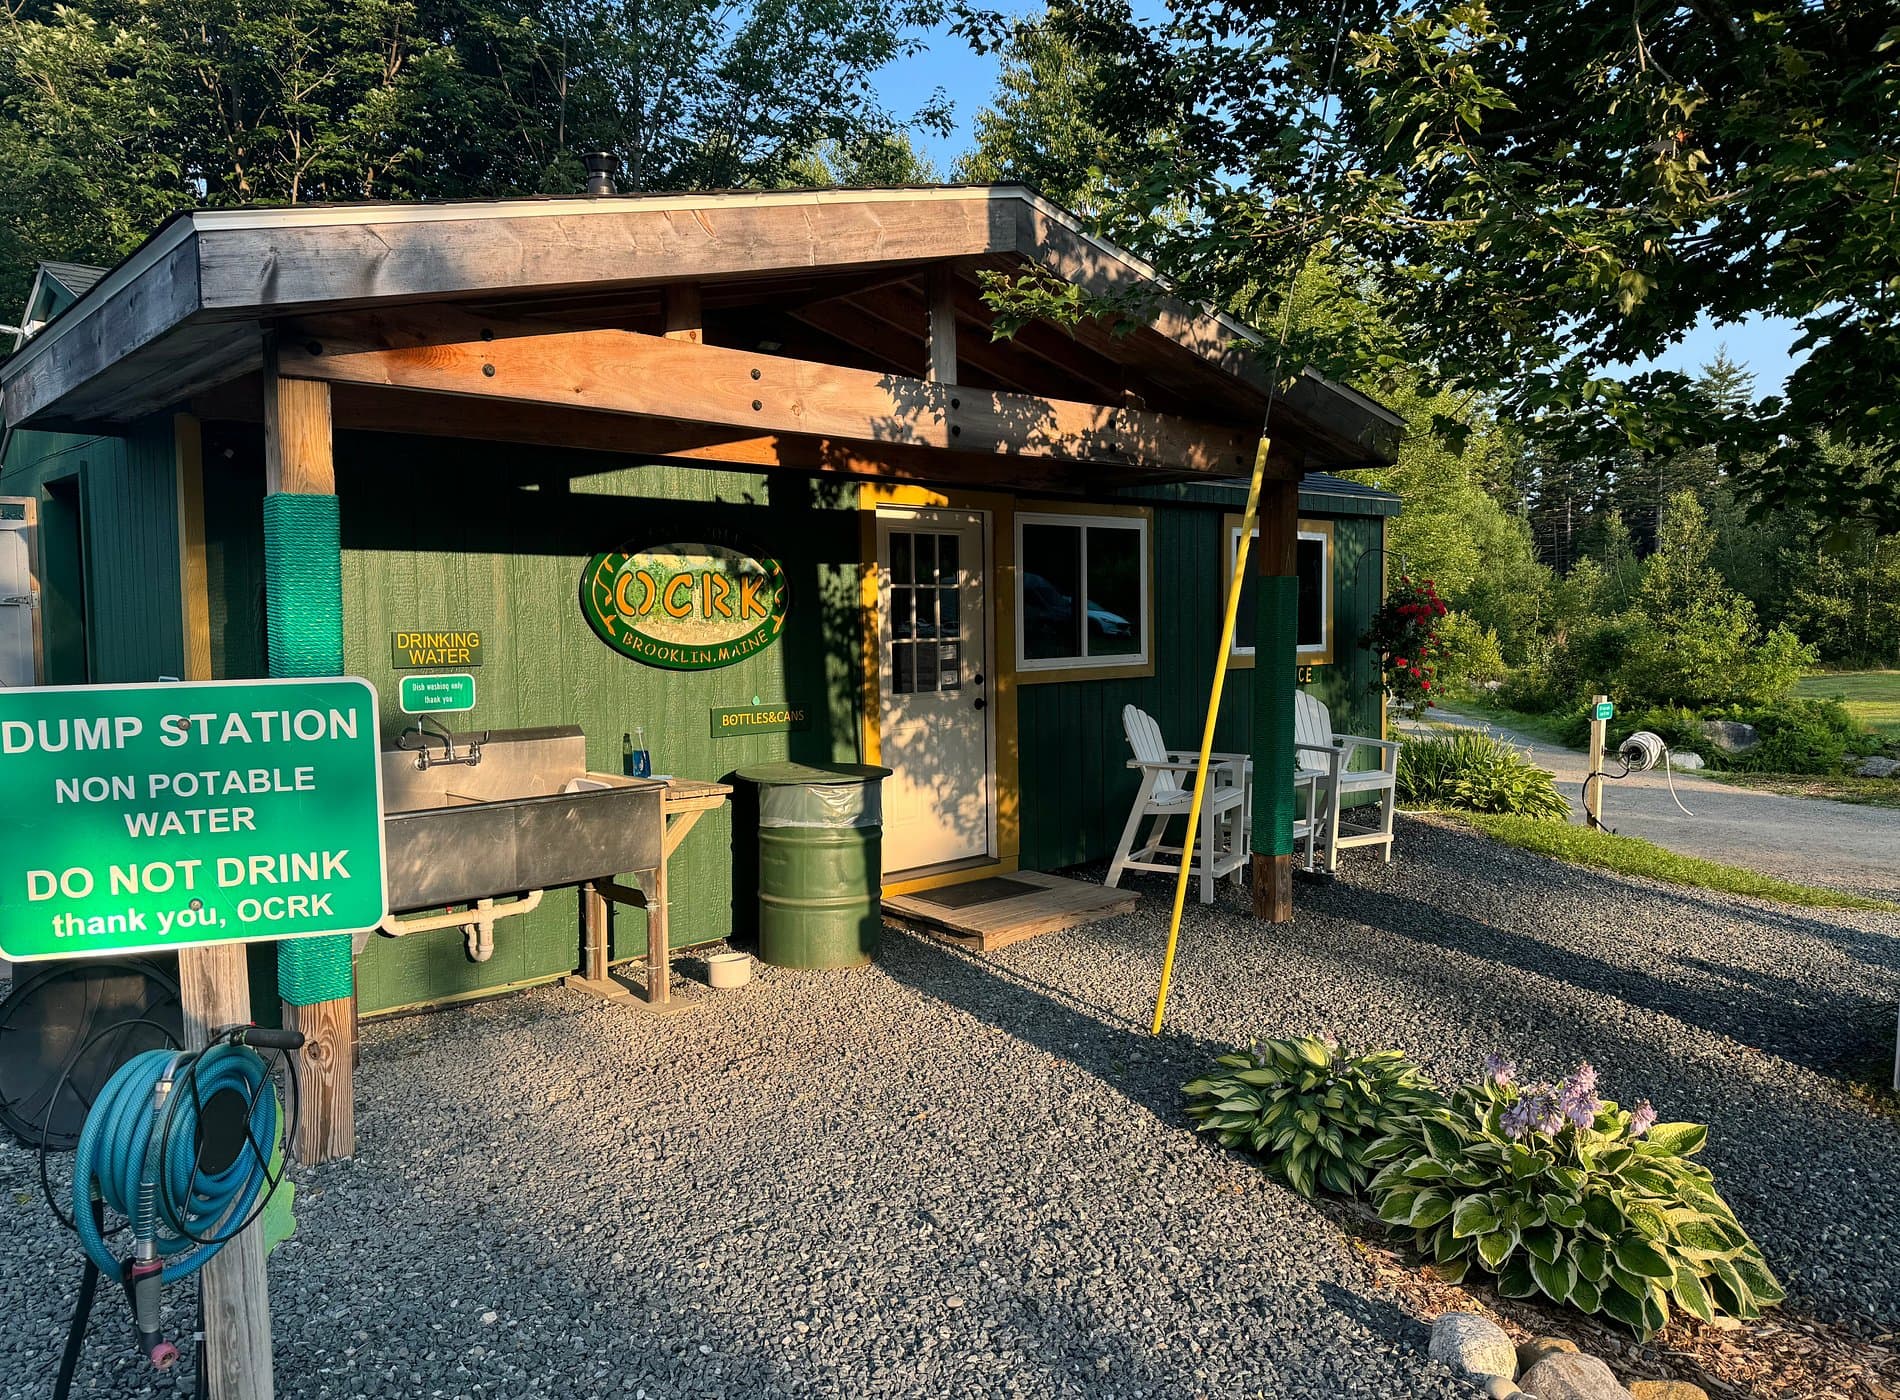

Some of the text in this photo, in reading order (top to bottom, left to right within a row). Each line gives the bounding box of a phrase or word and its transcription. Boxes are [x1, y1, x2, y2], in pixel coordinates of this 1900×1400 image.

[615, 571, 767, 619] OCRK
[397, 632, 480, 649] DRINKING
[409, 648, 471, 665] WATER
[424, 695, 453, 704] thank you
[427, 682, 449, 692] washing
[451, 681, 463, 691] only
[1, 708, 358, 754] DUMP STATION
[55, 766, 316, 804] NON POTABLE
[123, 806, 257, 838] WATER
[26, 849, 352, 902] DO NOT DRINK
[52, 892, 334, 938] thank you, OCRK
